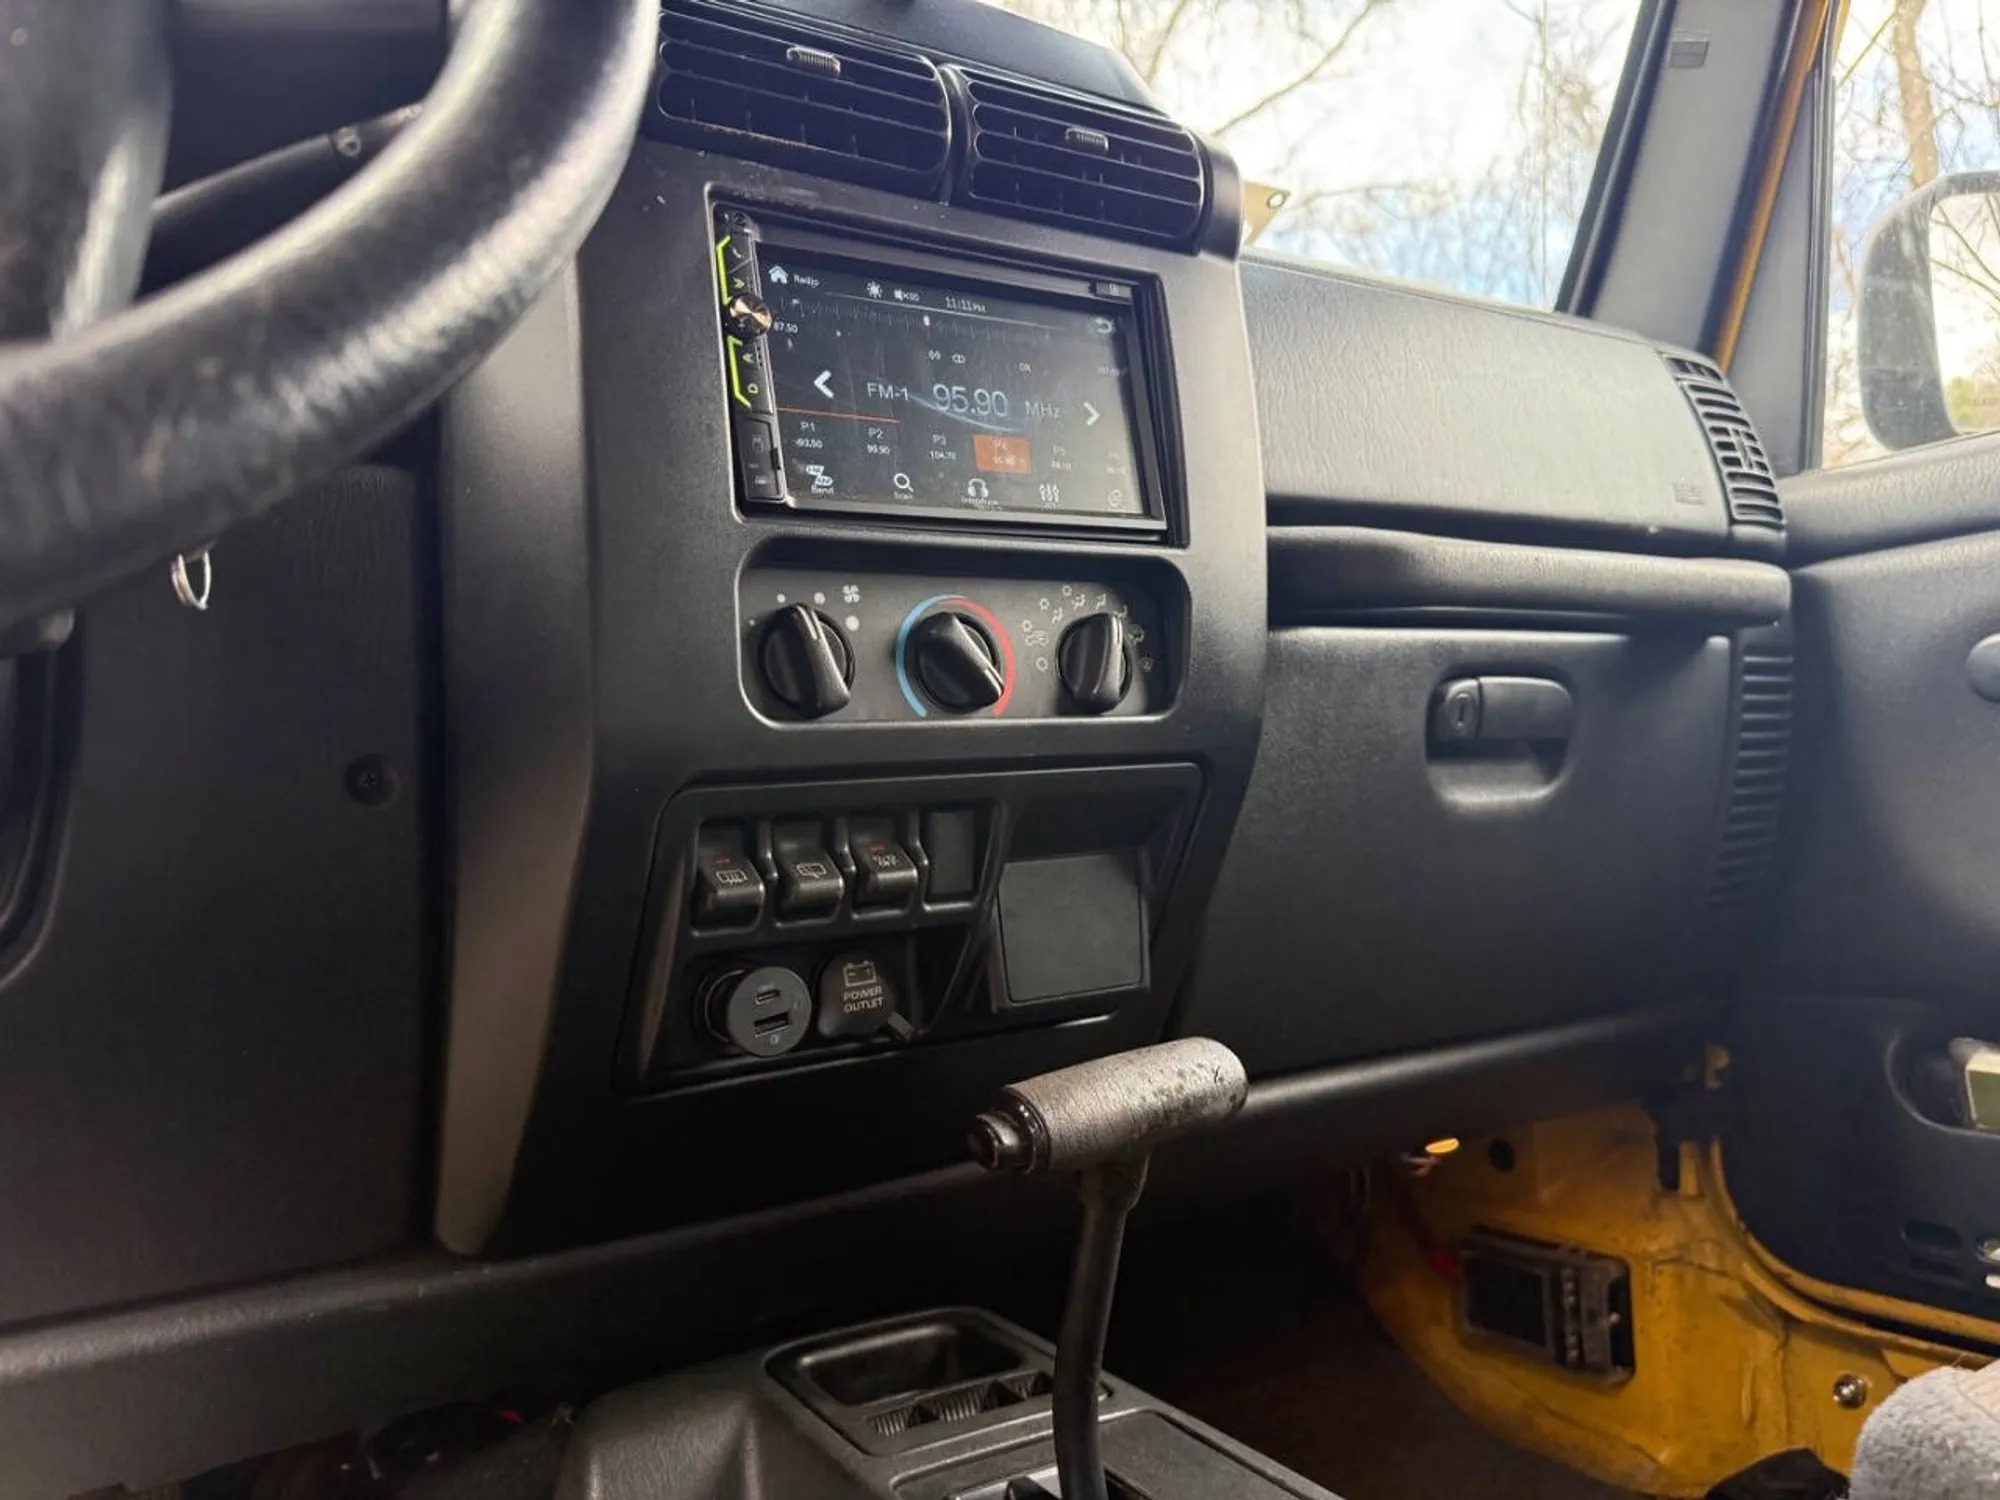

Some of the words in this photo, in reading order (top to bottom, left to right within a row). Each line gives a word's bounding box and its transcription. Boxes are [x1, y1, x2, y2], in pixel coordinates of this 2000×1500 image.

[866, 381, 909, 401] FM-1
[932, 383, 1008, 418] 95.90
[1025, 400, 1061, 418] MHz
[843, 985, 883, 1001] POWER
[843, 996, 884, 1012] OUTLET
